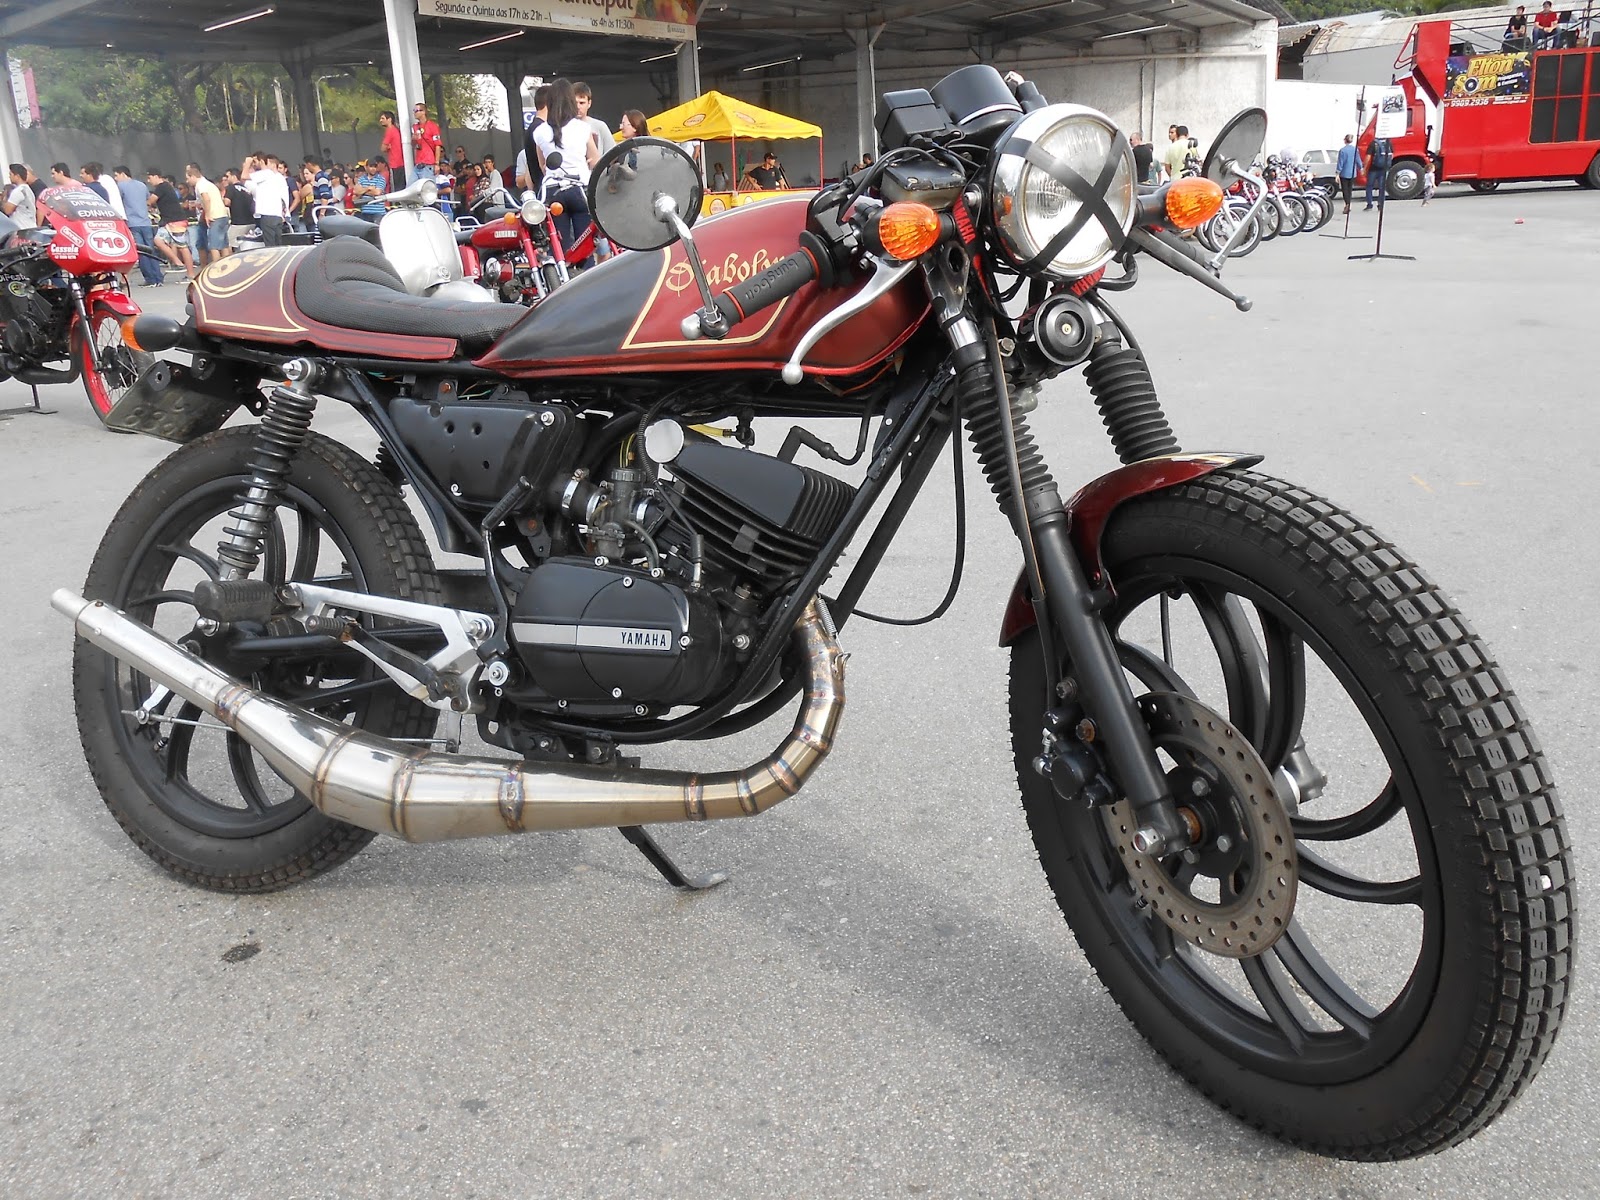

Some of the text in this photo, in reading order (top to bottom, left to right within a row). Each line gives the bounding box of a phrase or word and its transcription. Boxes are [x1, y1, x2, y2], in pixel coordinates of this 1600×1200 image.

[435, 1, 465, 14] Segunda
[472, 5, 495, 17] Quinta
[496, 8, 507, 18] das
[509, 8, 521, 19] 17h
[530, 10, 542, 21] 21h
[616, 19, 635, 30] 11:30h
[1468, 57, 1514, 76] Elton
[78, 209, 115, 218] EDINHO
[93, 237, 125, 249] 716
[621, 631, 666, 647] YAMAHA
